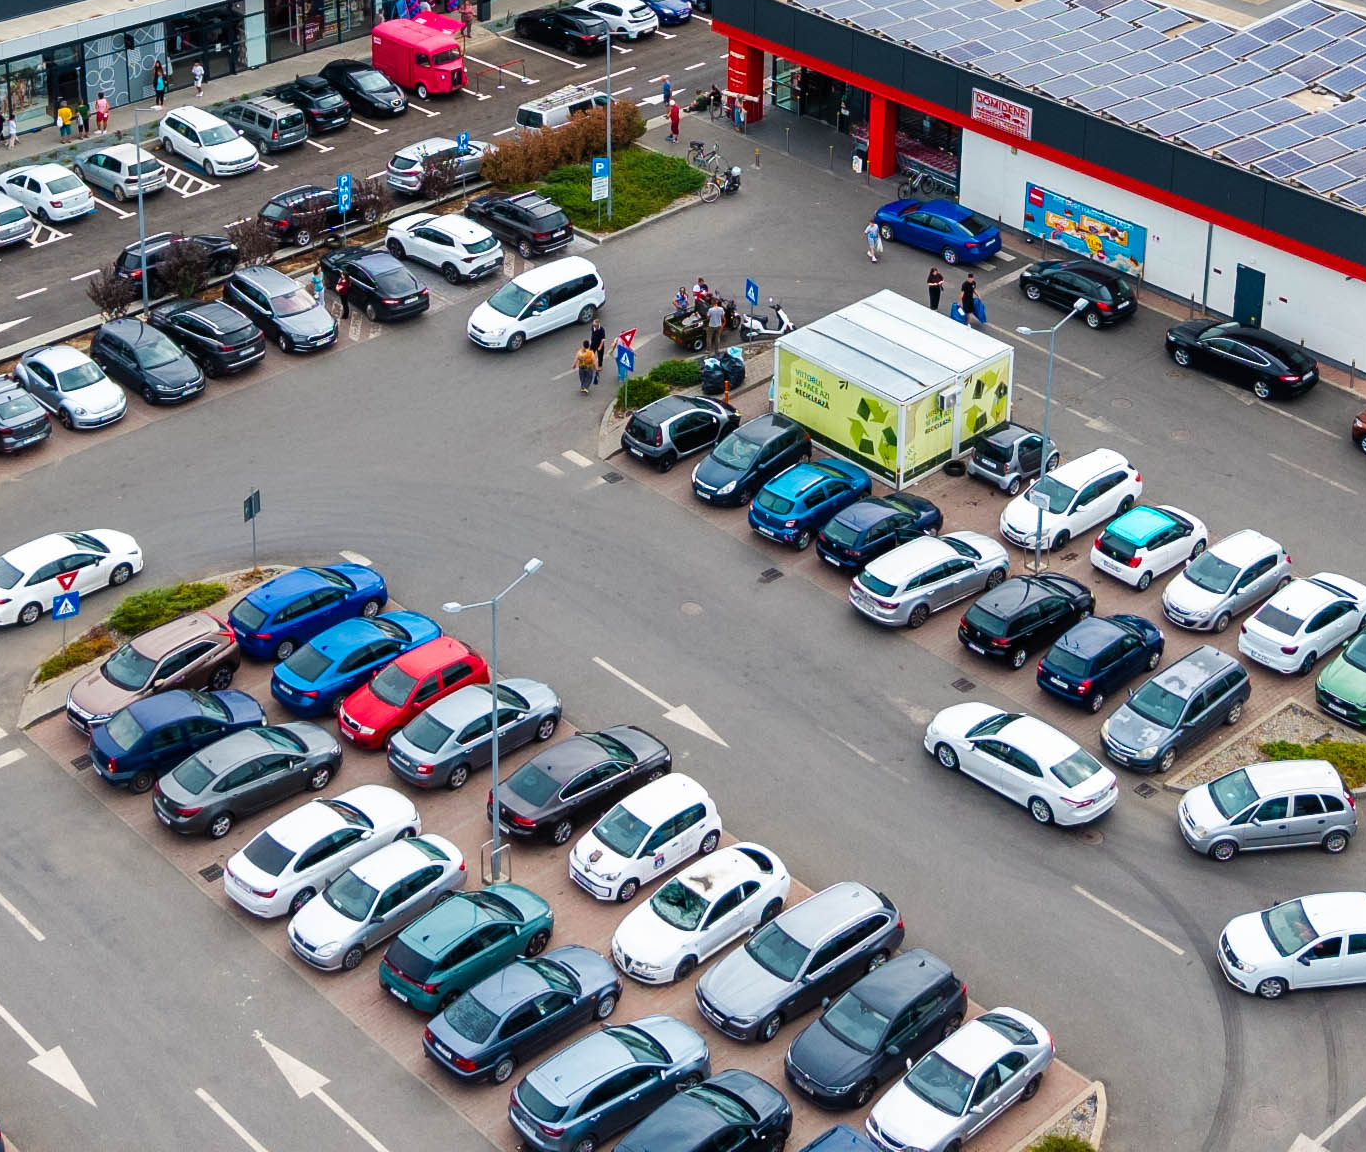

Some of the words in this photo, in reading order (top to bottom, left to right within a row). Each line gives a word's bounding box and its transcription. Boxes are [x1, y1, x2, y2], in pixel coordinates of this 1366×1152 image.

[460, 134, 466, 144] P
[596, 162, 605, 174] P
[341, 176, 348, 186] P
[341, 194, 348, 205] P
